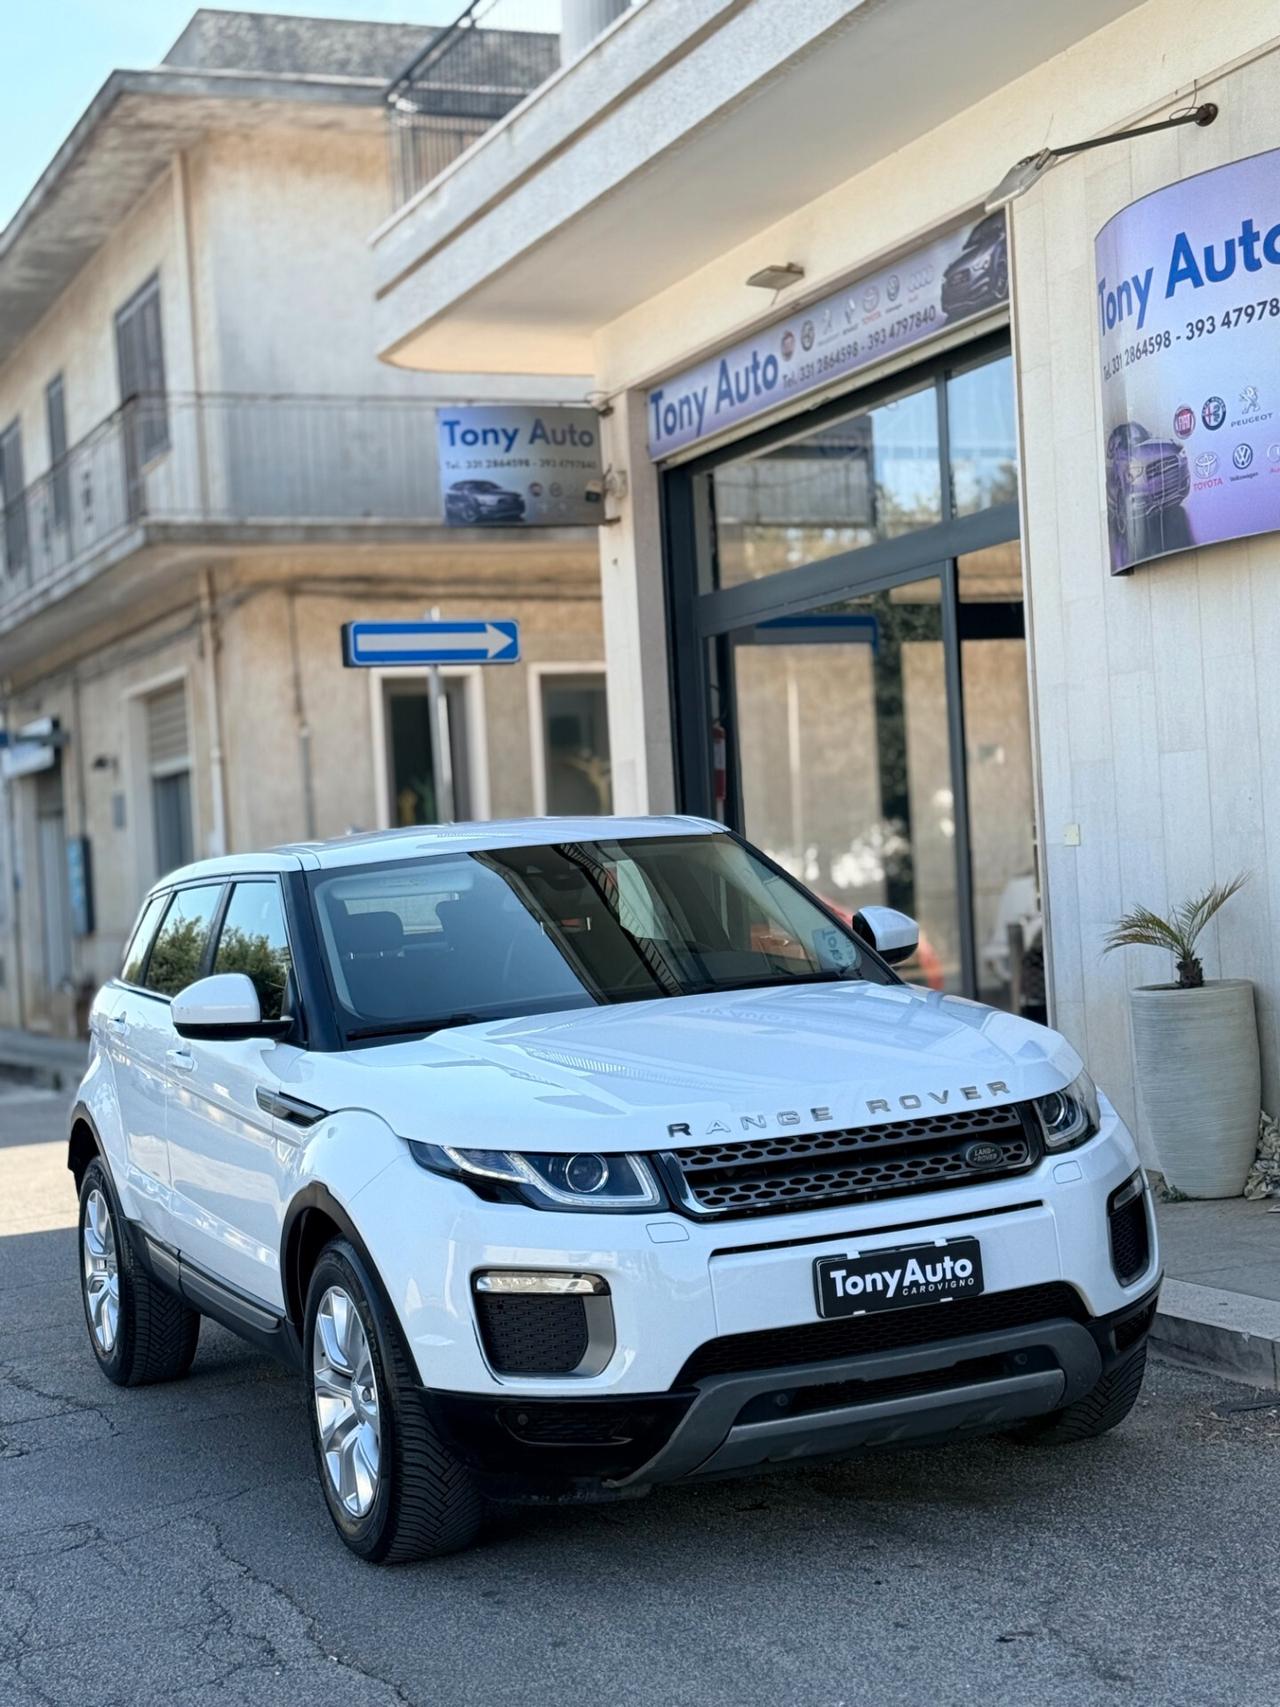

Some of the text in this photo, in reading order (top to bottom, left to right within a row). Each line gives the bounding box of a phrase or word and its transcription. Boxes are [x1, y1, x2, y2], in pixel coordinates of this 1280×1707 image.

[1098, 267, 1154, 337] Tony
[868, 328, 887, 351] 393
[1124, 330, 1171, 367] 2864598
[1186, 315, 1216, 341] 393
[651, 350, 778, 441] Tony Auto
[442, 418, 594, 453] Tony Auto
[1231, 412, 1273, 428] PEUGEOT
[1193, 478, 1223, 492] TOYOTA
[667, 1081, 1010, 1138] RANGE ROVER
[902, 1278, 975, 1296] CAROVIGNO
